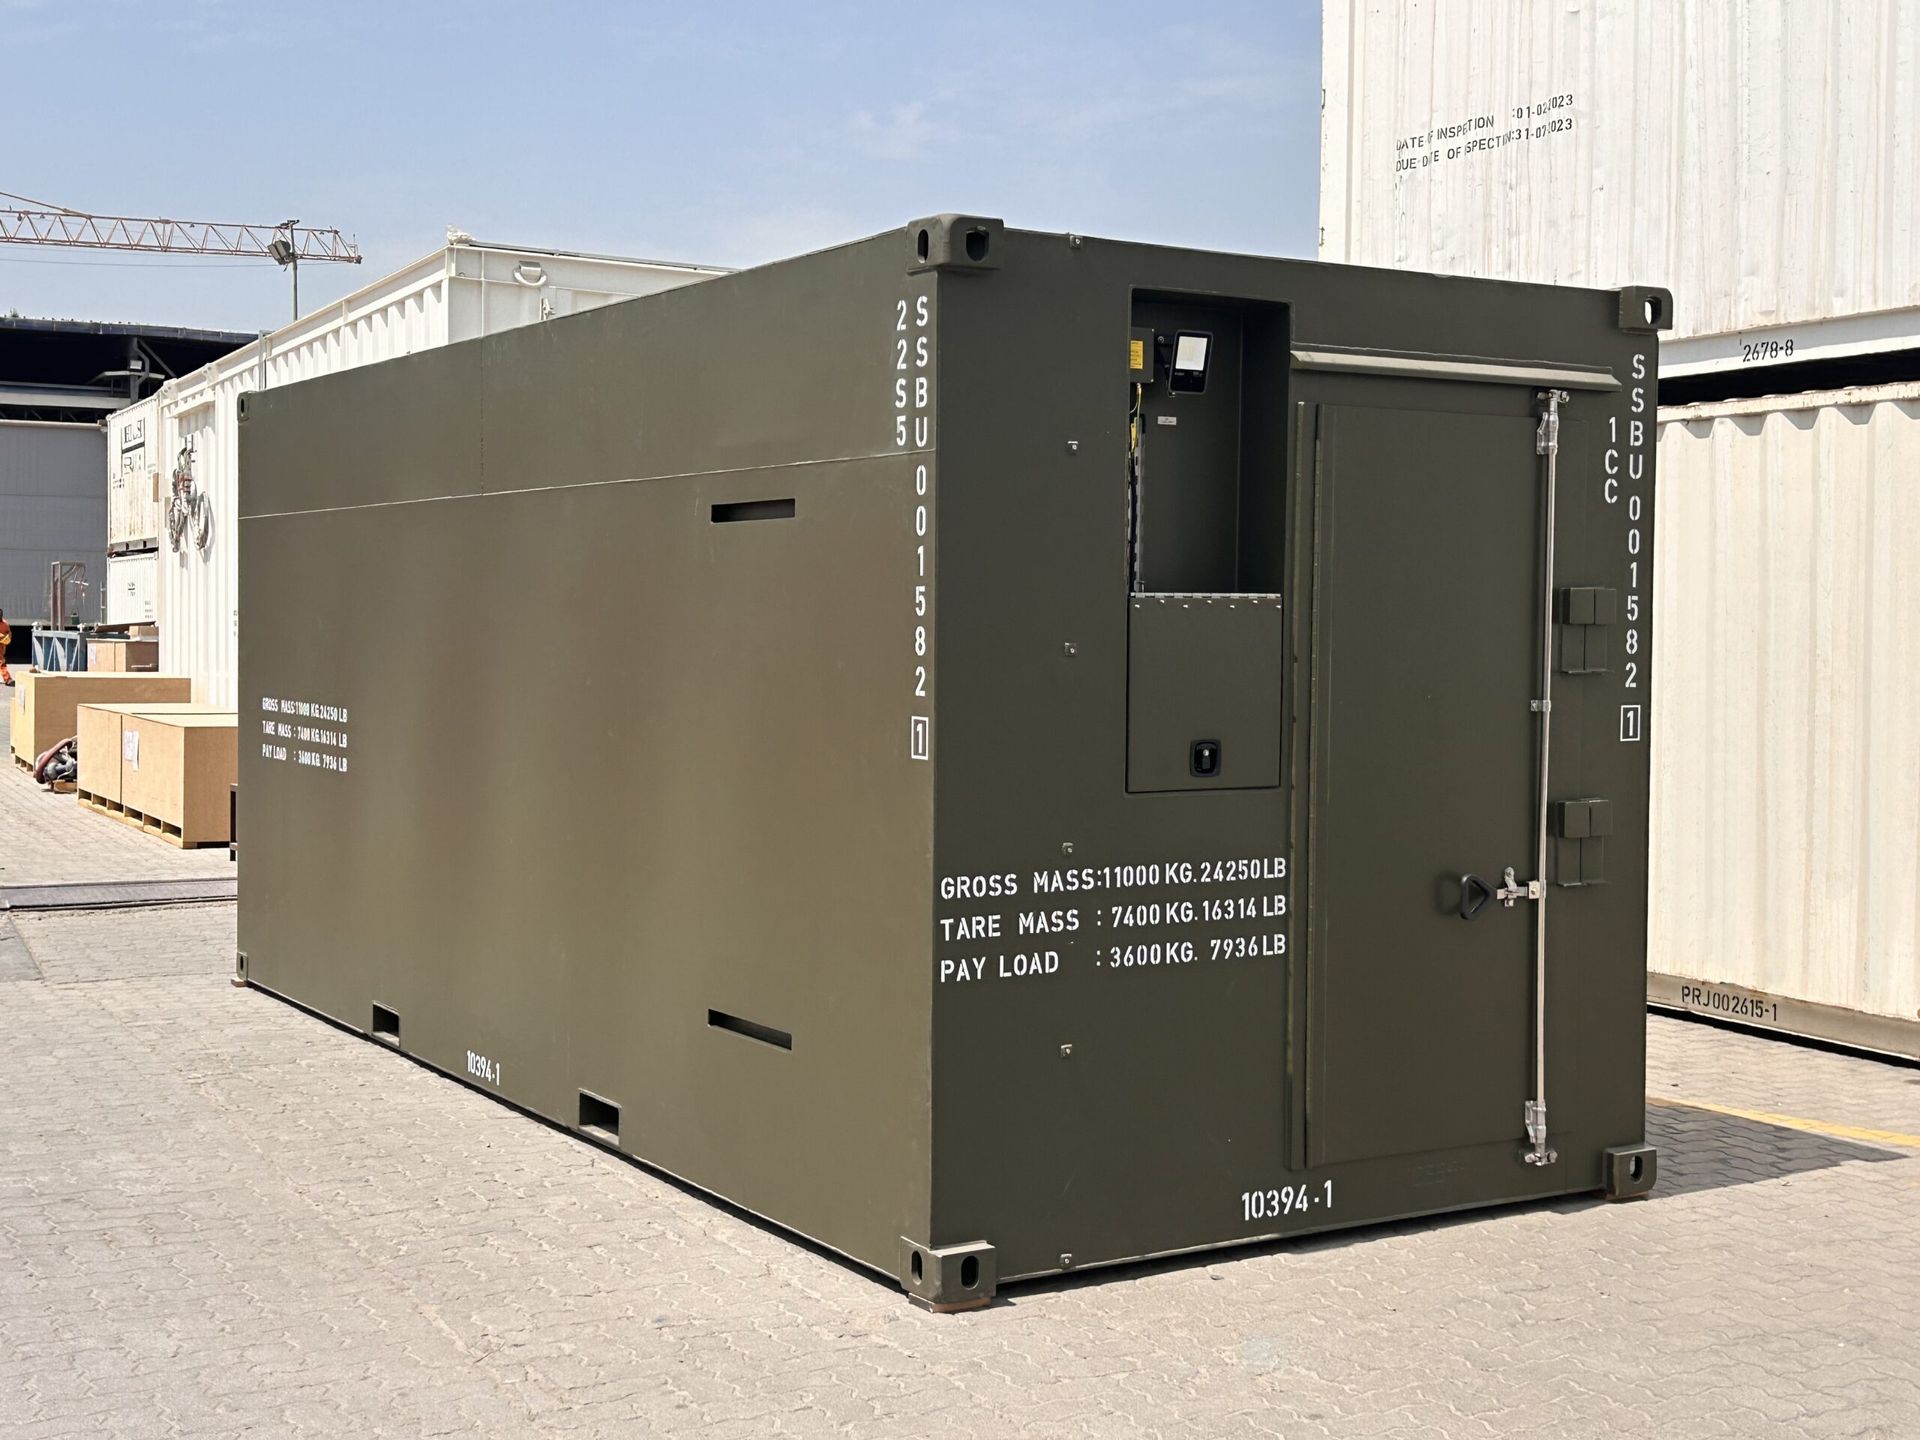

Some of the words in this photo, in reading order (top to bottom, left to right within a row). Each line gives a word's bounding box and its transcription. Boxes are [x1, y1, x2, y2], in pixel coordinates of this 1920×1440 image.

[1395, 157, 1417, 172] DUE
[1422, 150, 1440, 167] DTE
[1447, 146, 1462, 160] OF
[1396, 135, 1424, 151] DATE
[1742, 339, 1795, 363] 2678-8
[915, 295, 929, 448] SSBU
[1628, 353, 1646, 480] SSBU
[1604, 416, 1619, 504] 1CC
[915, 464, 927, 697] 001582
[1624, 495, 1641, 689] 001582
[262, 697, 279, 712] GROSS
[262, 720, 276, 736] TARE
[278, 722, 292, 739] MASS
[262, 743, 272, 759] PAY
[273, 746, 287, 761] LOAD
[940, 873, 1018, 900] GROSS
[939, 914, 1001, 942] TARE
[1018, 909, 1080, 936] MASS
[940, 956, 987, 984] PAY
[999, 950, 1060, 978] LOAD
[1681, 985, 1778, 1022] PRJ002615-1
[467, 1049, 501, 1087] 10394-1
[1241, 1179, 1333, 1222] 10394-1
